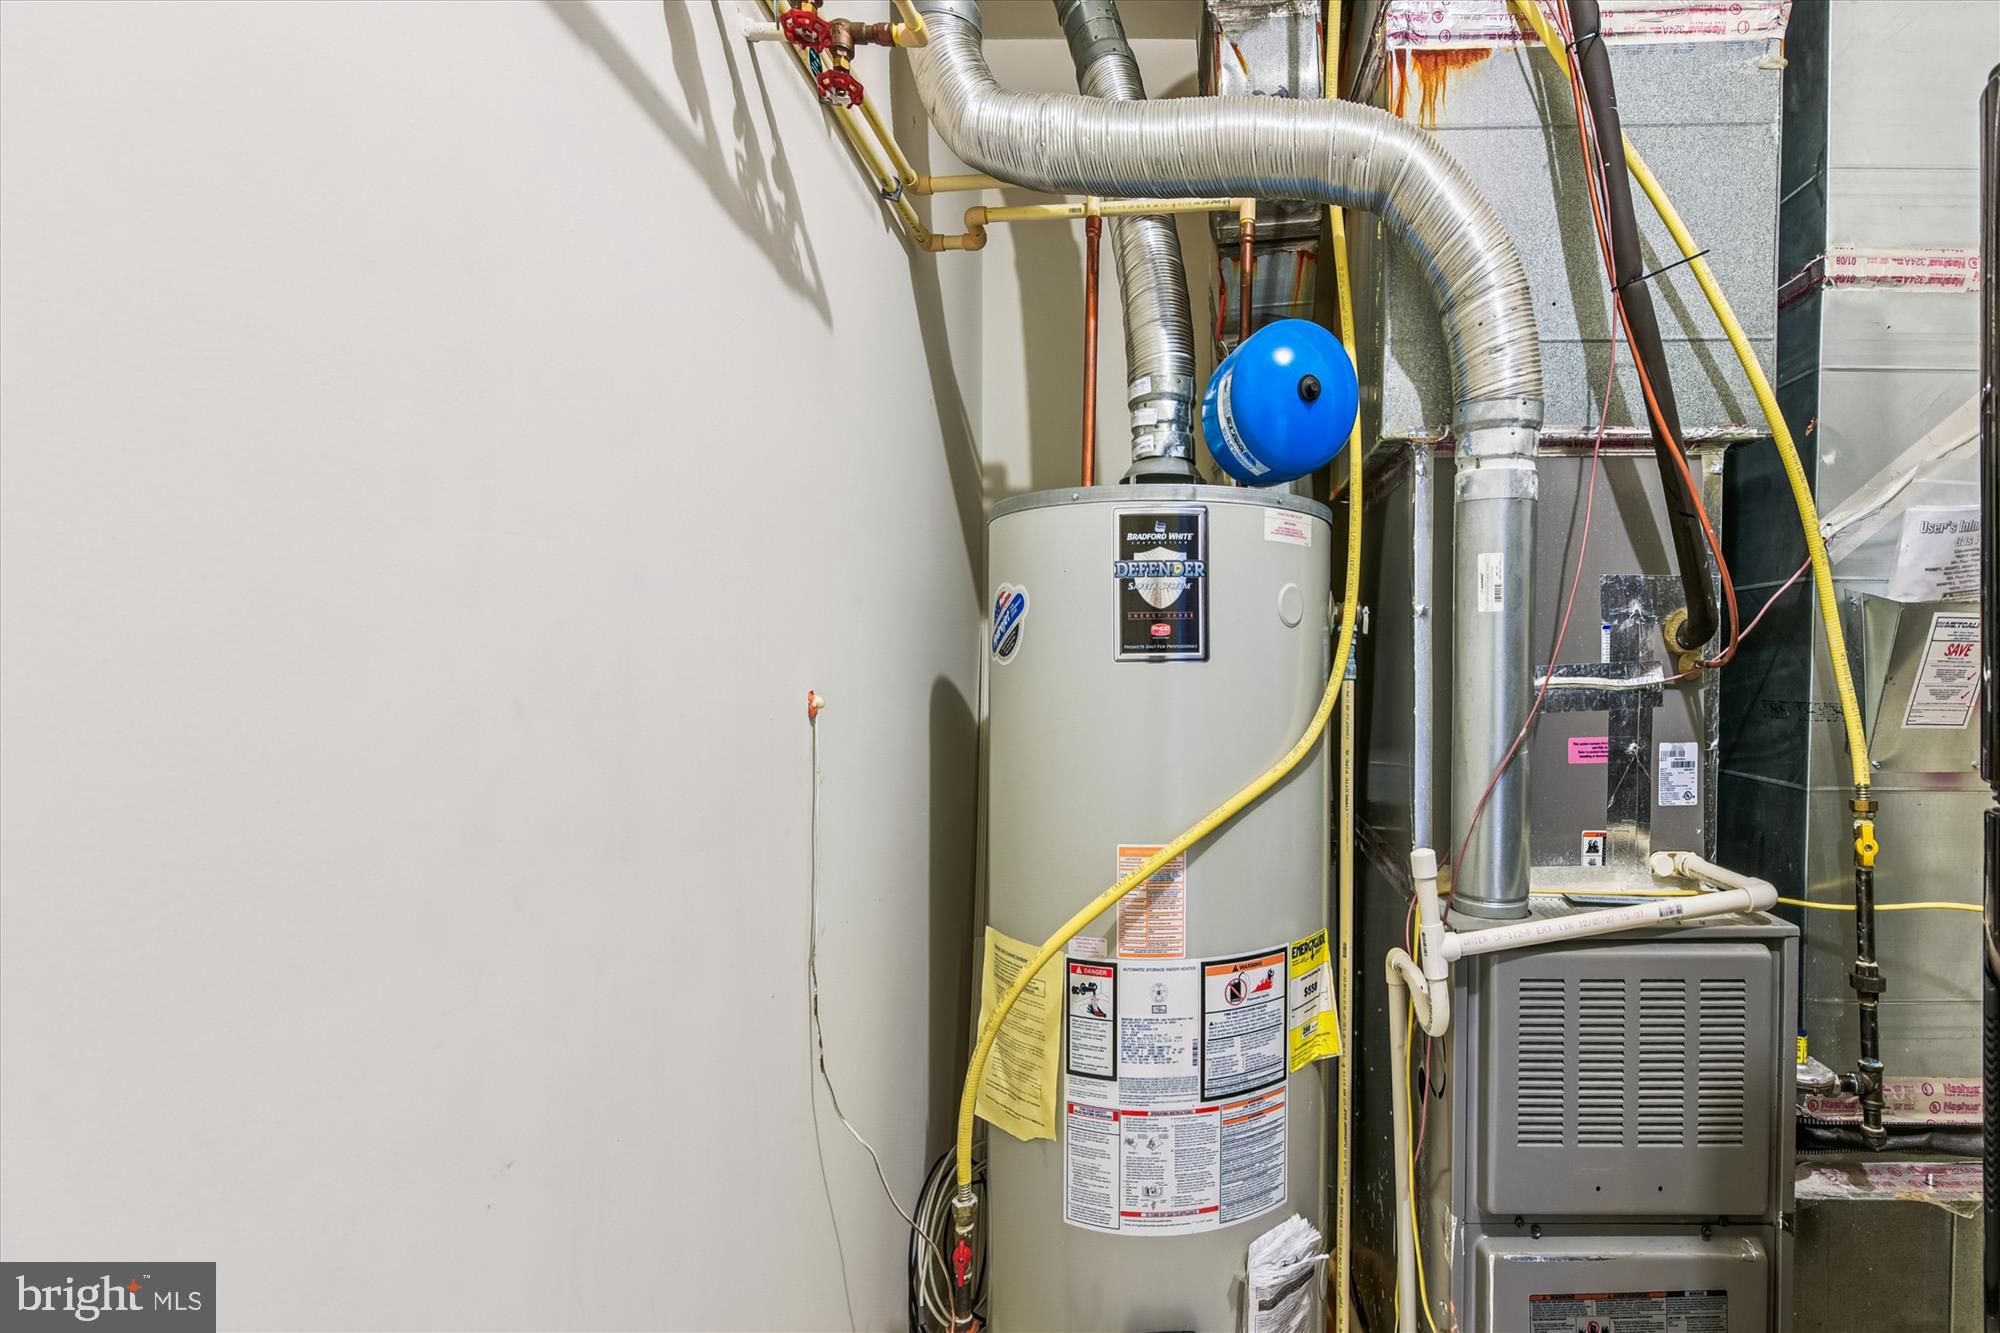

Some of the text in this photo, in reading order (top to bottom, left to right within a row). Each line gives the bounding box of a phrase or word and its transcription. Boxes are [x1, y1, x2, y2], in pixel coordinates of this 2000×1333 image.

[1835, 256, 1966, 268] Nashua 324A 01/08
[1835, 274, 1966, 287] Nashua 324A 01/08
[1920, 520, 1958, 534] User's
[1127, 532, 1193, 541] BRADFORD WHITE
[1115, 561, 1206, 578] DEFENDER
[1944, 643, 1974, 657] SAVE
[1239, 961, 1263, 970] WARNING
[1083, 967, 1108, 977] DANGER
[1943, 1083, 1981, 1093] Nashua
[1821, 1099, 1858, 1109] Nashua
[1943, 1101, 1981, 1111] Nashua
